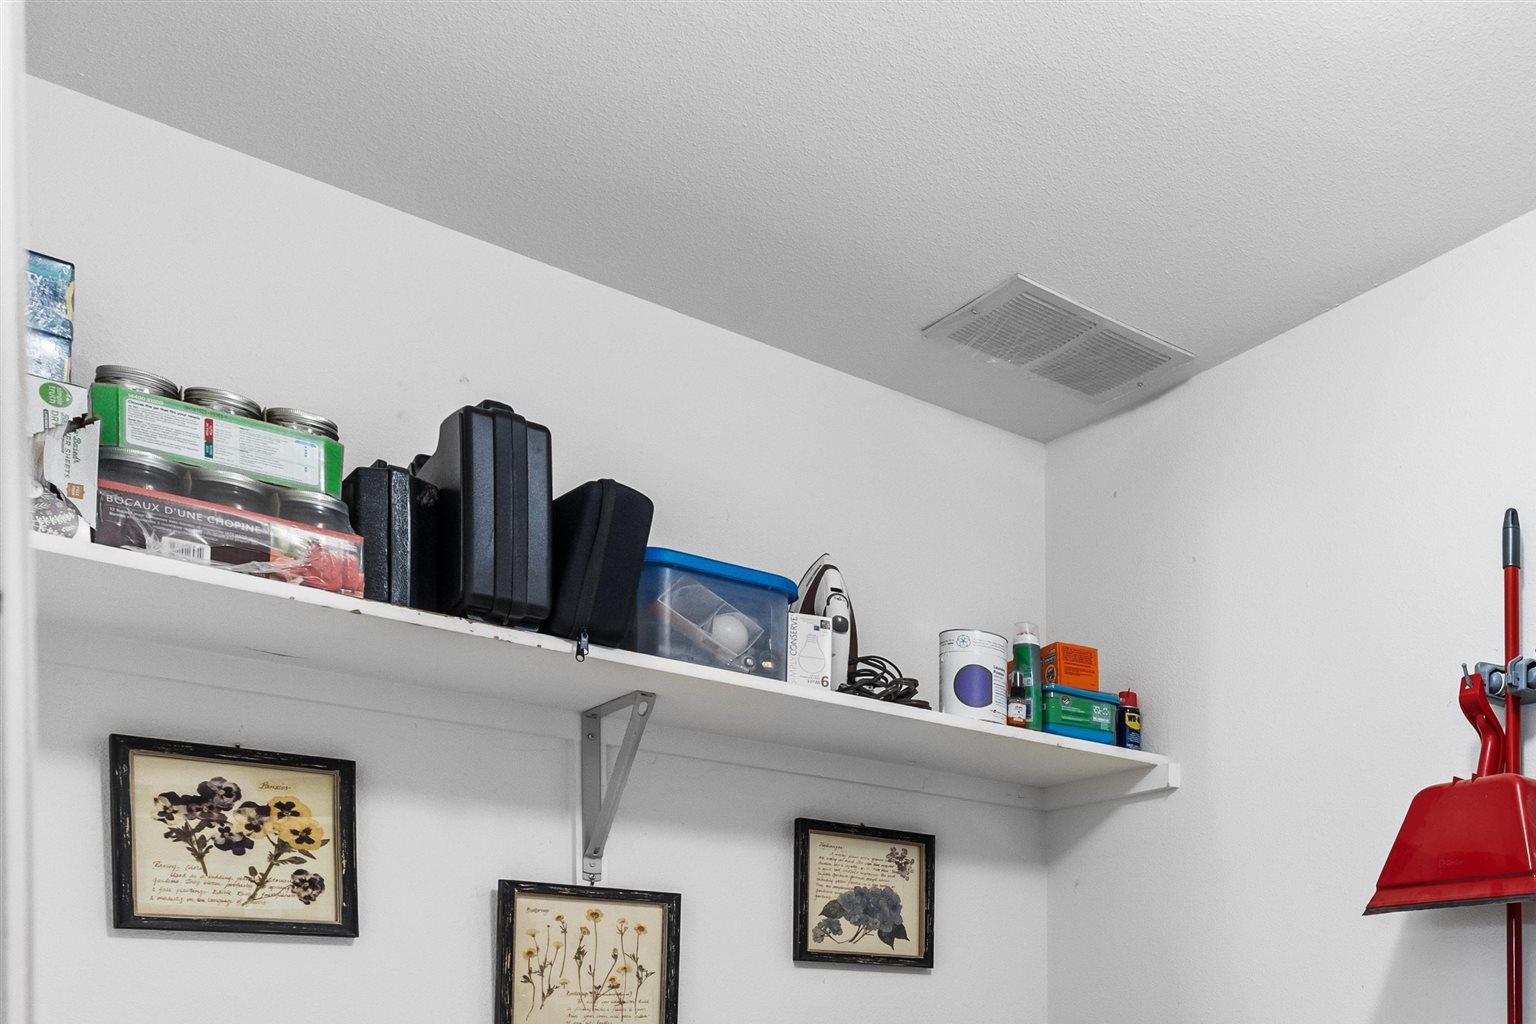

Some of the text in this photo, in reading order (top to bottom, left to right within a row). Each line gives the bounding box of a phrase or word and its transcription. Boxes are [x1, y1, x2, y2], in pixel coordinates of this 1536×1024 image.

[106, 494, 160, 513] BOCAUX
[164, 506, 203, 522] D'UNE
[821, 676, 830, 688] 6
